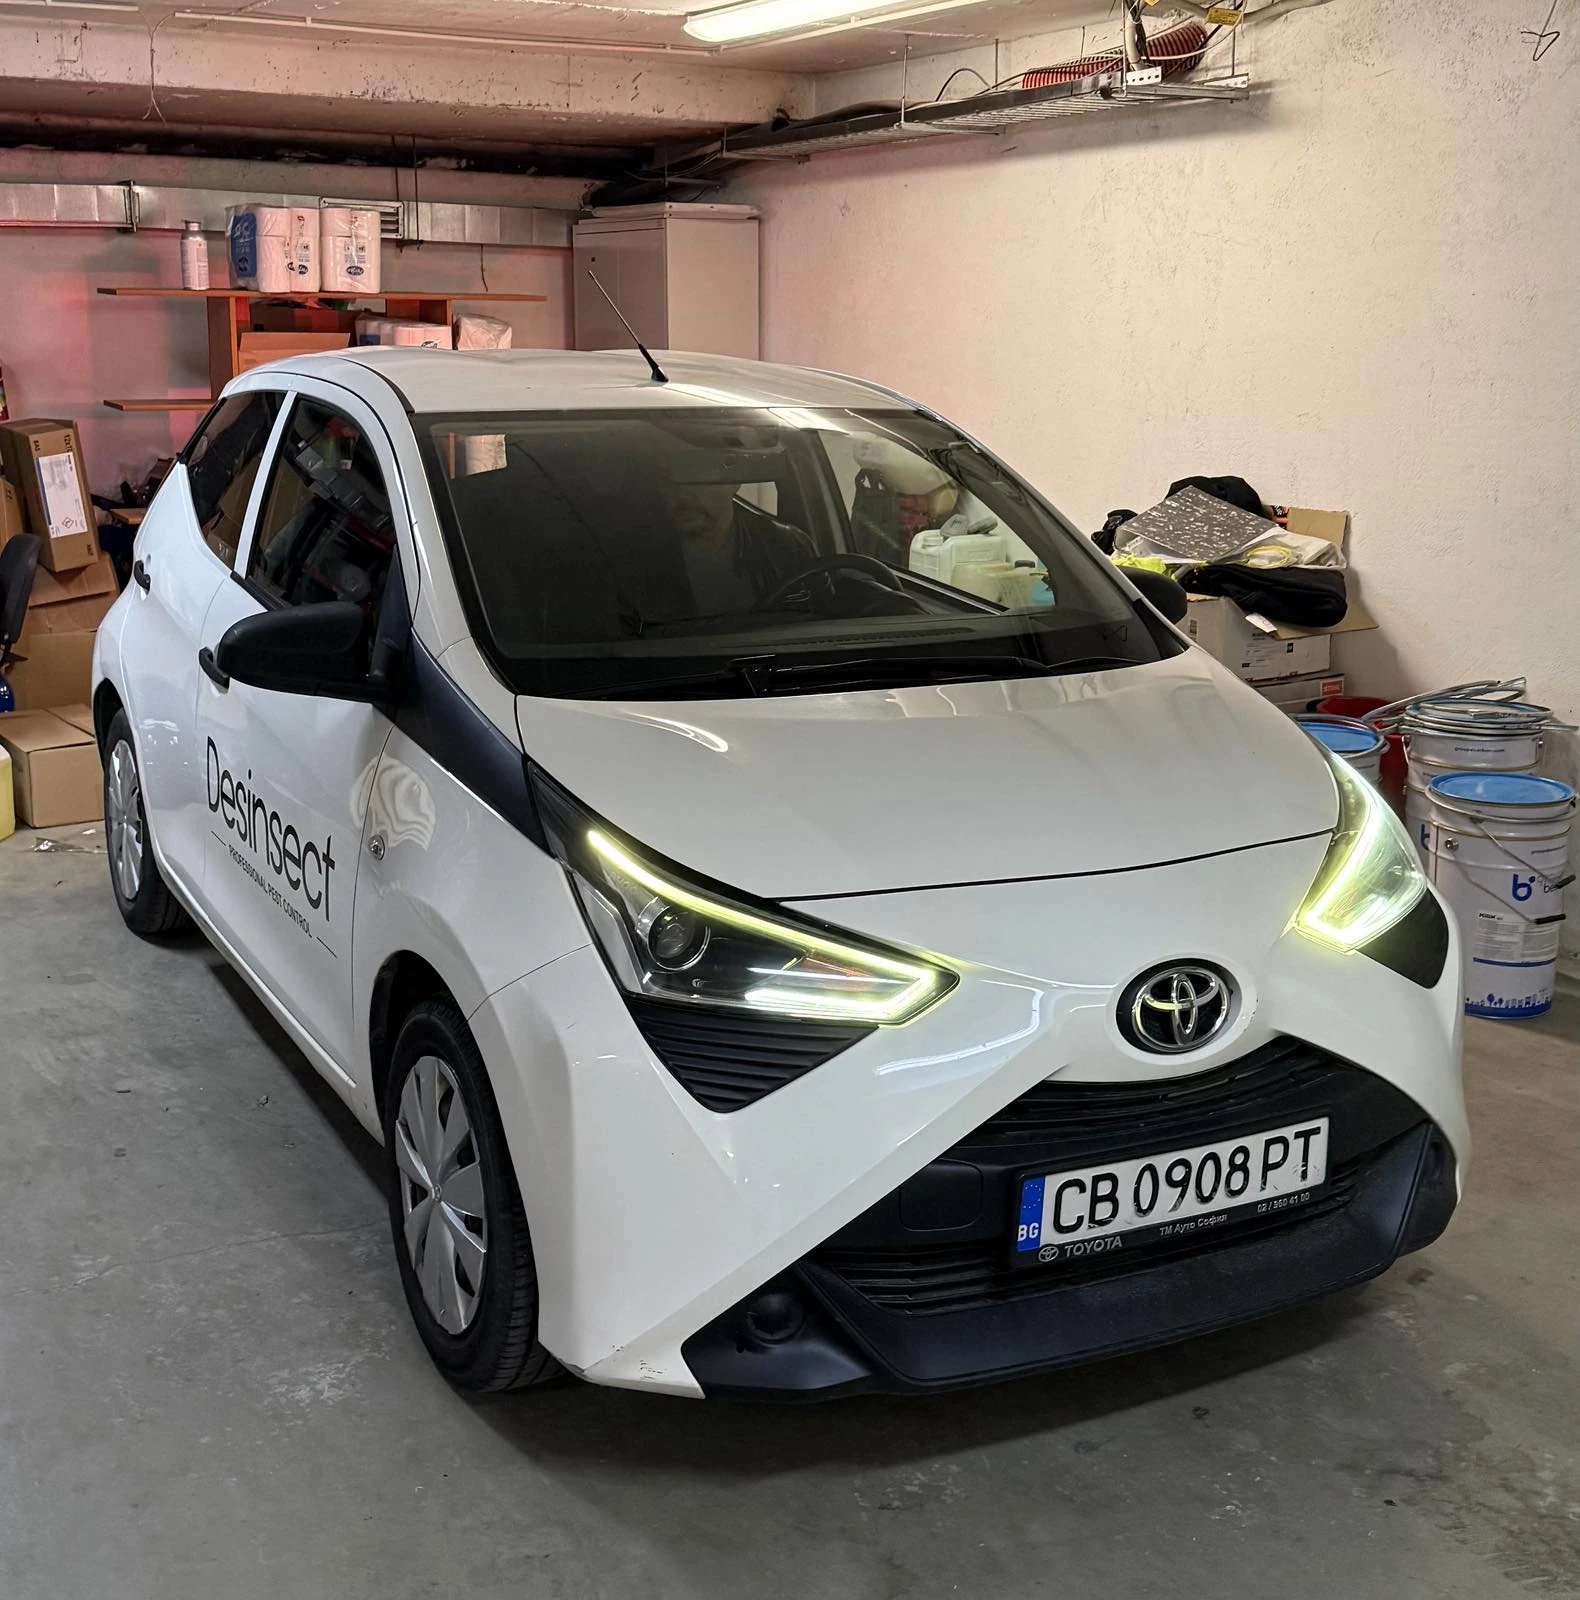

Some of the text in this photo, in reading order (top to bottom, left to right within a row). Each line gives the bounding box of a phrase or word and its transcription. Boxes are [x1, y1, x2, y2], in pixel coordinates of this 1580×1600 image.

[206, 735, 336, 922] Desinsect
[228, 844, 312, 938] PROFESSIONAL PEST CONTROL
[1052, 1126, 1321, 1236] CB 0908 PT
[1257, 1202, 1268, 1213] 02
[1289, 1195, 1299, 1206] 41
[1300, 1191, 1311, 1202] 00
[1017, 1221, 1039, 1243] BG
[1197, 1213, 1228, 1230] София
[1064, 1235, 1123, 1259] TOYOTA
